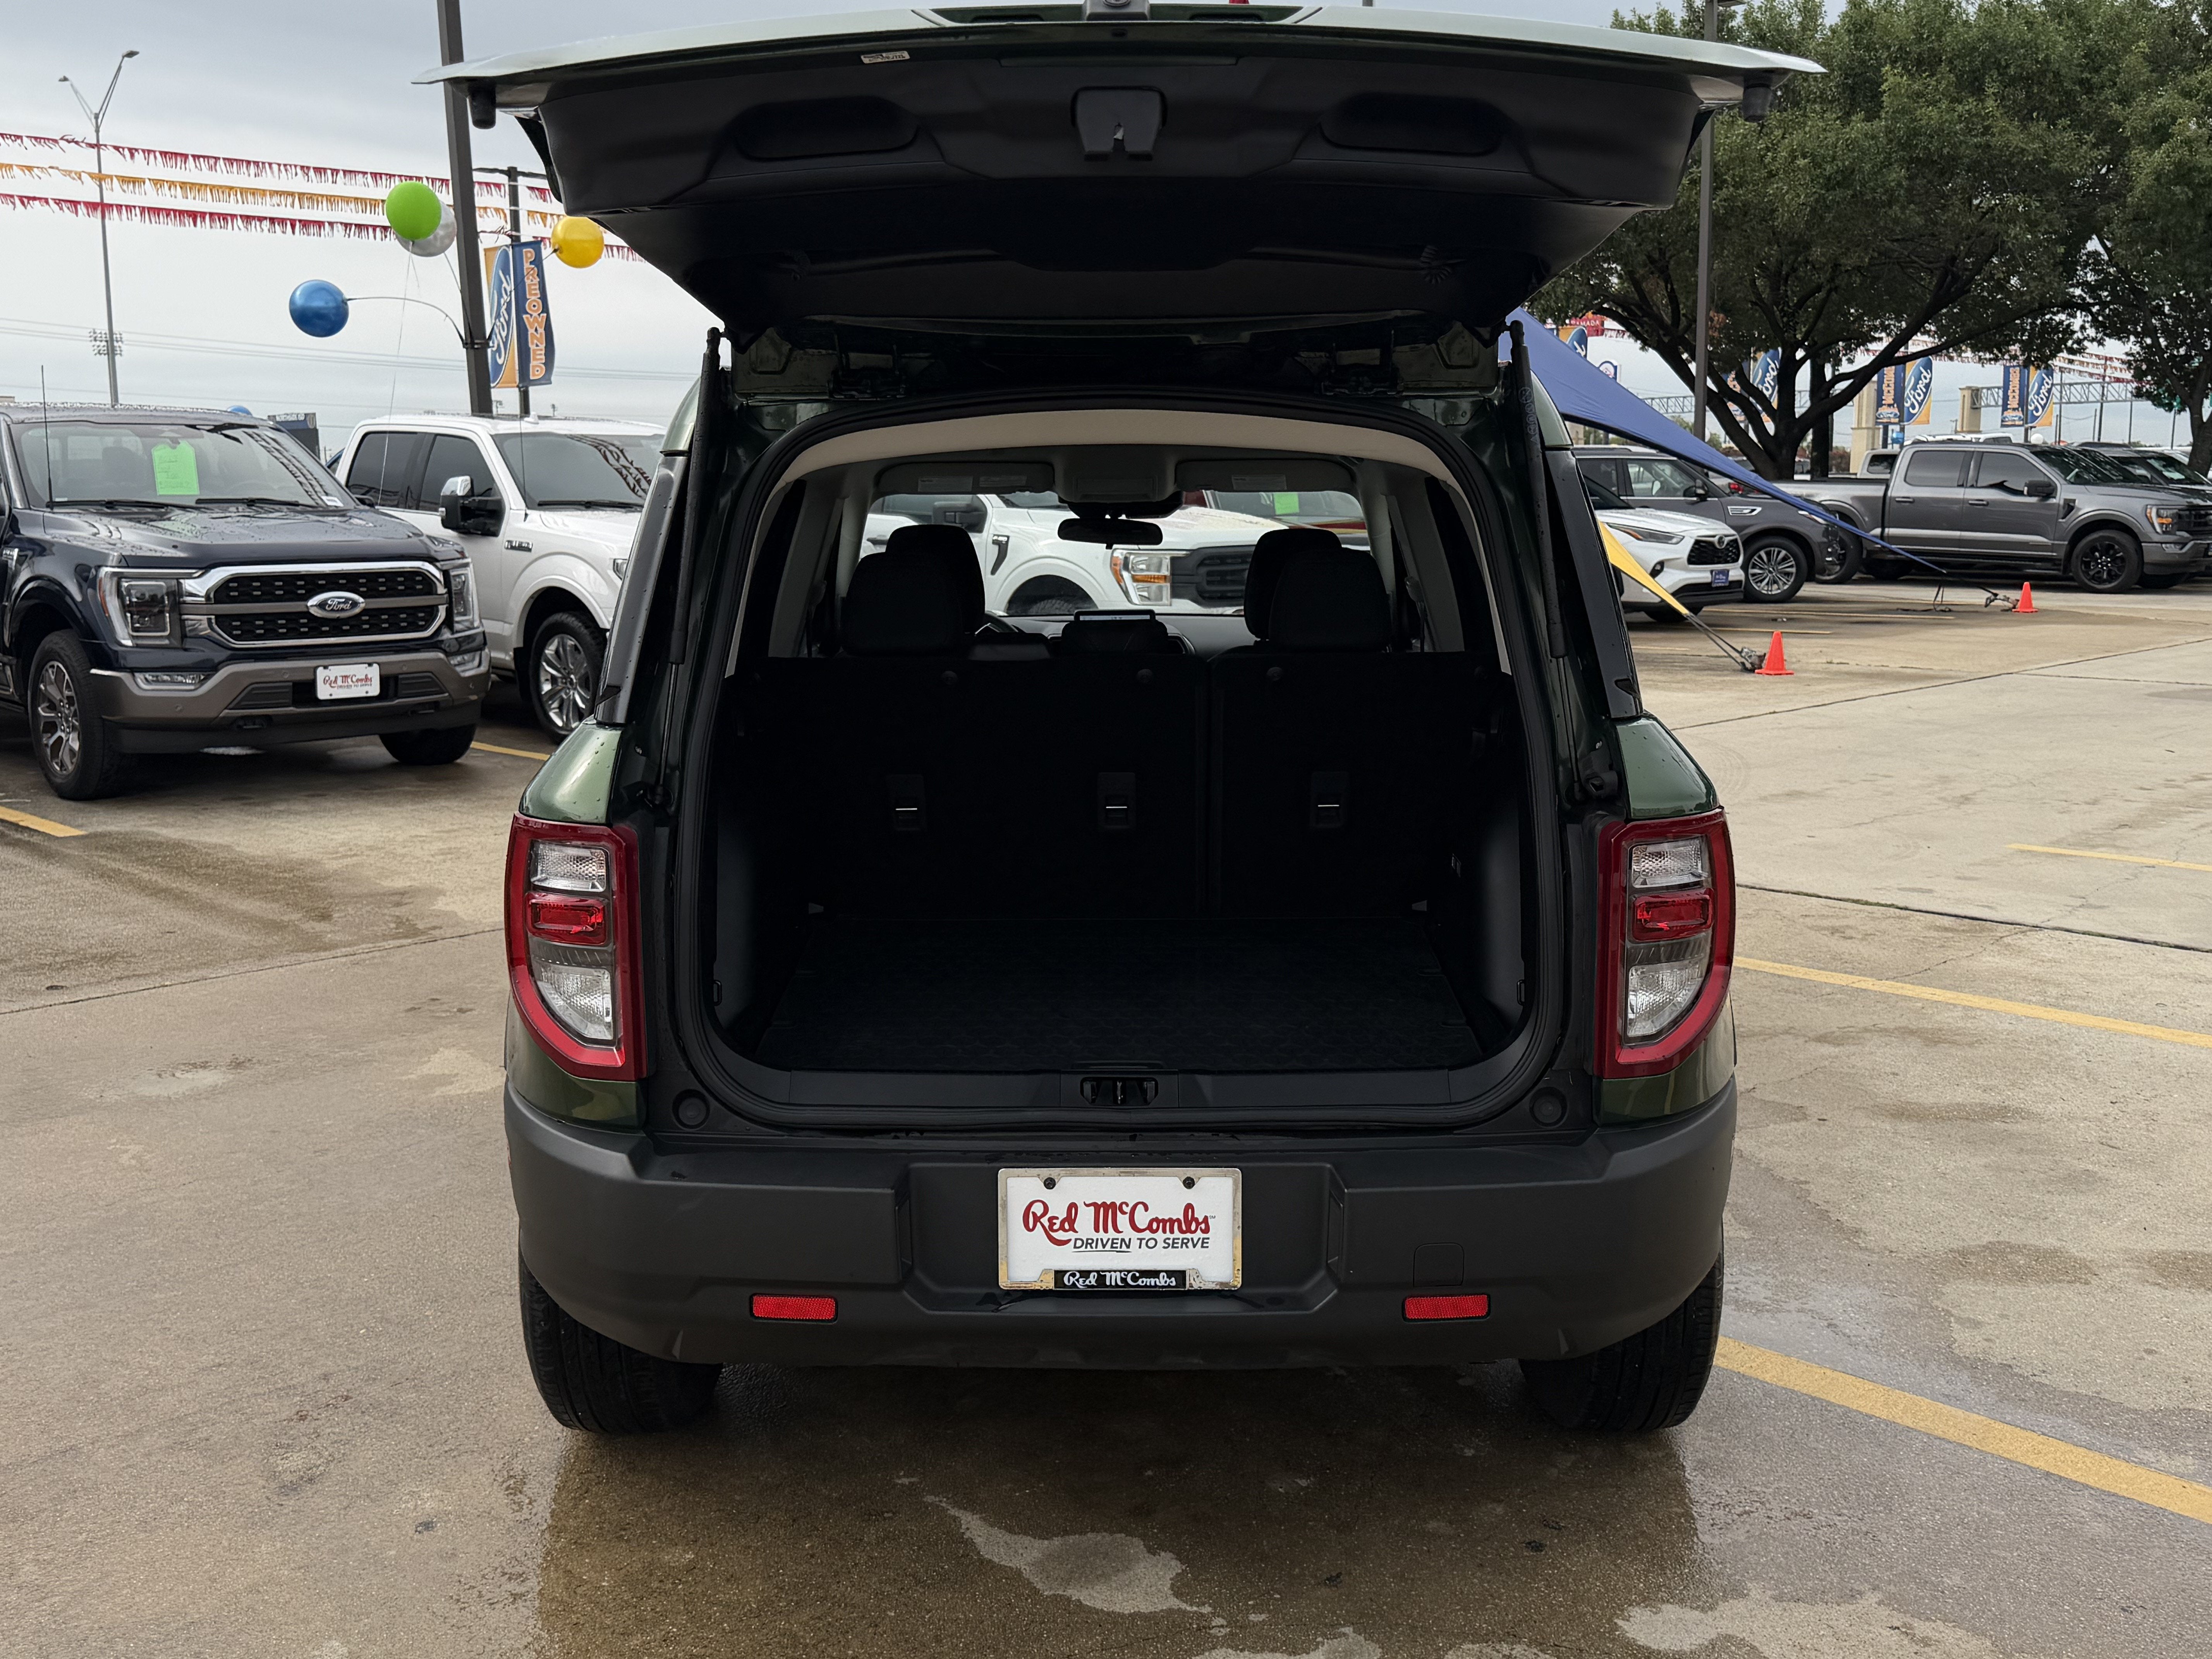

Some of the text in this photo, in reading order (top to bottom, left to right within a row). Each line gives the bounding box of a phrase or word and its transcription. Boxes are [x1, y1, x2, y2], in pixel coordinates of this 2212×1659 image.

[489, 269, 512, 365] Ford
[523, 248, 547, 380] PREOWNED
[1904, 367, 1931, 414] Ford
[2028, 374, 2053, 416] Ford
[326, 598, 352, 610] Ford
[1022, 1199, 1079, 1246] Red
[1084, 1201, 1211, 1235] McCombs
[1073, 1237, 1210, 1249] DRIVEN TO SERVE
[1064, 1271, 1176, 1288] Red McCombs
